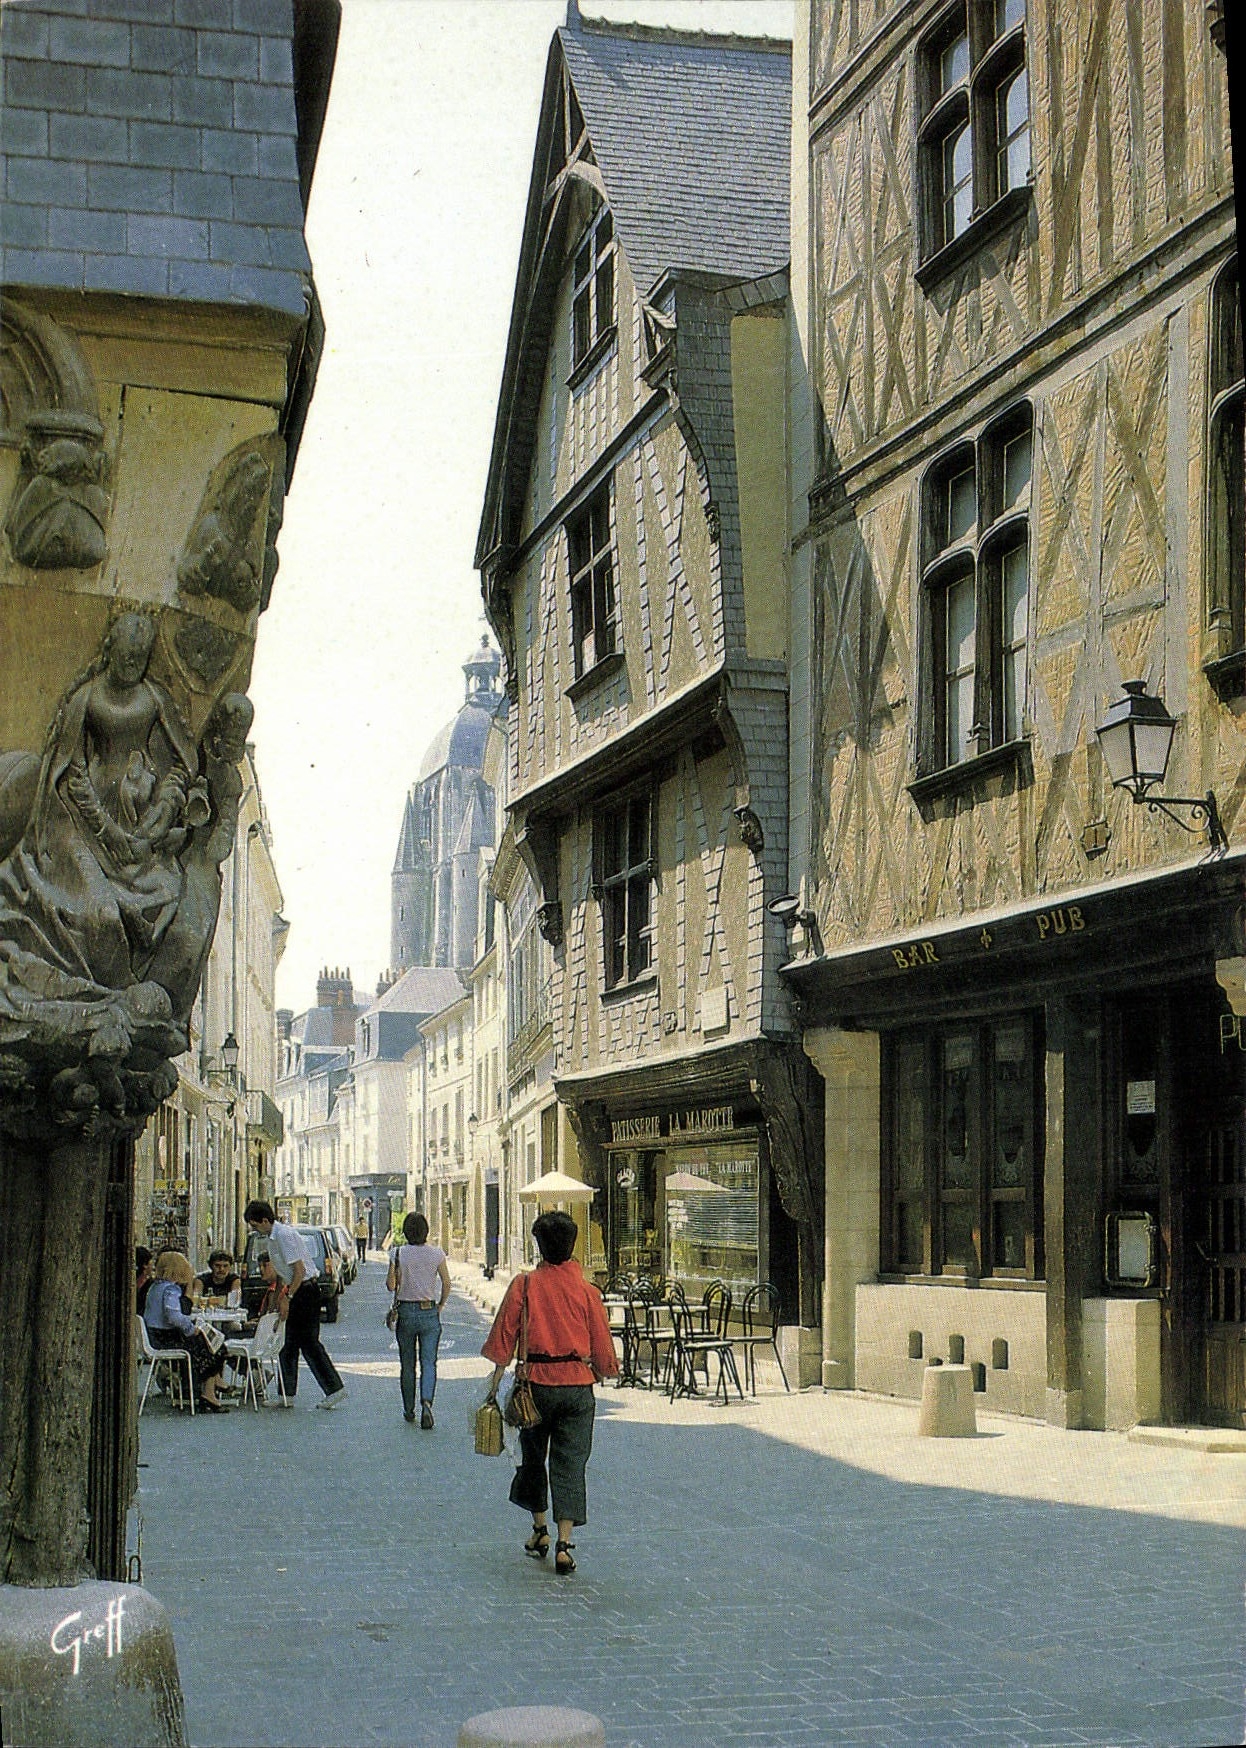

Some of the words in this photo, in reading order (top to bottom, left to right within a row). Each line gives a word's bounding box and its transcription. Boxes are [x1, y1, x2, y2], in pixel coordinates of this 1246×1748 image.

[891, 941, 940, 969] BAR
[1035, 906, 1086, 939] PUB
[611, 1116, 660, 1142] PATISSERIE
[669, 1112, 681, 1136] LA
[685, 1106, 734, 1132] MAROTTE
